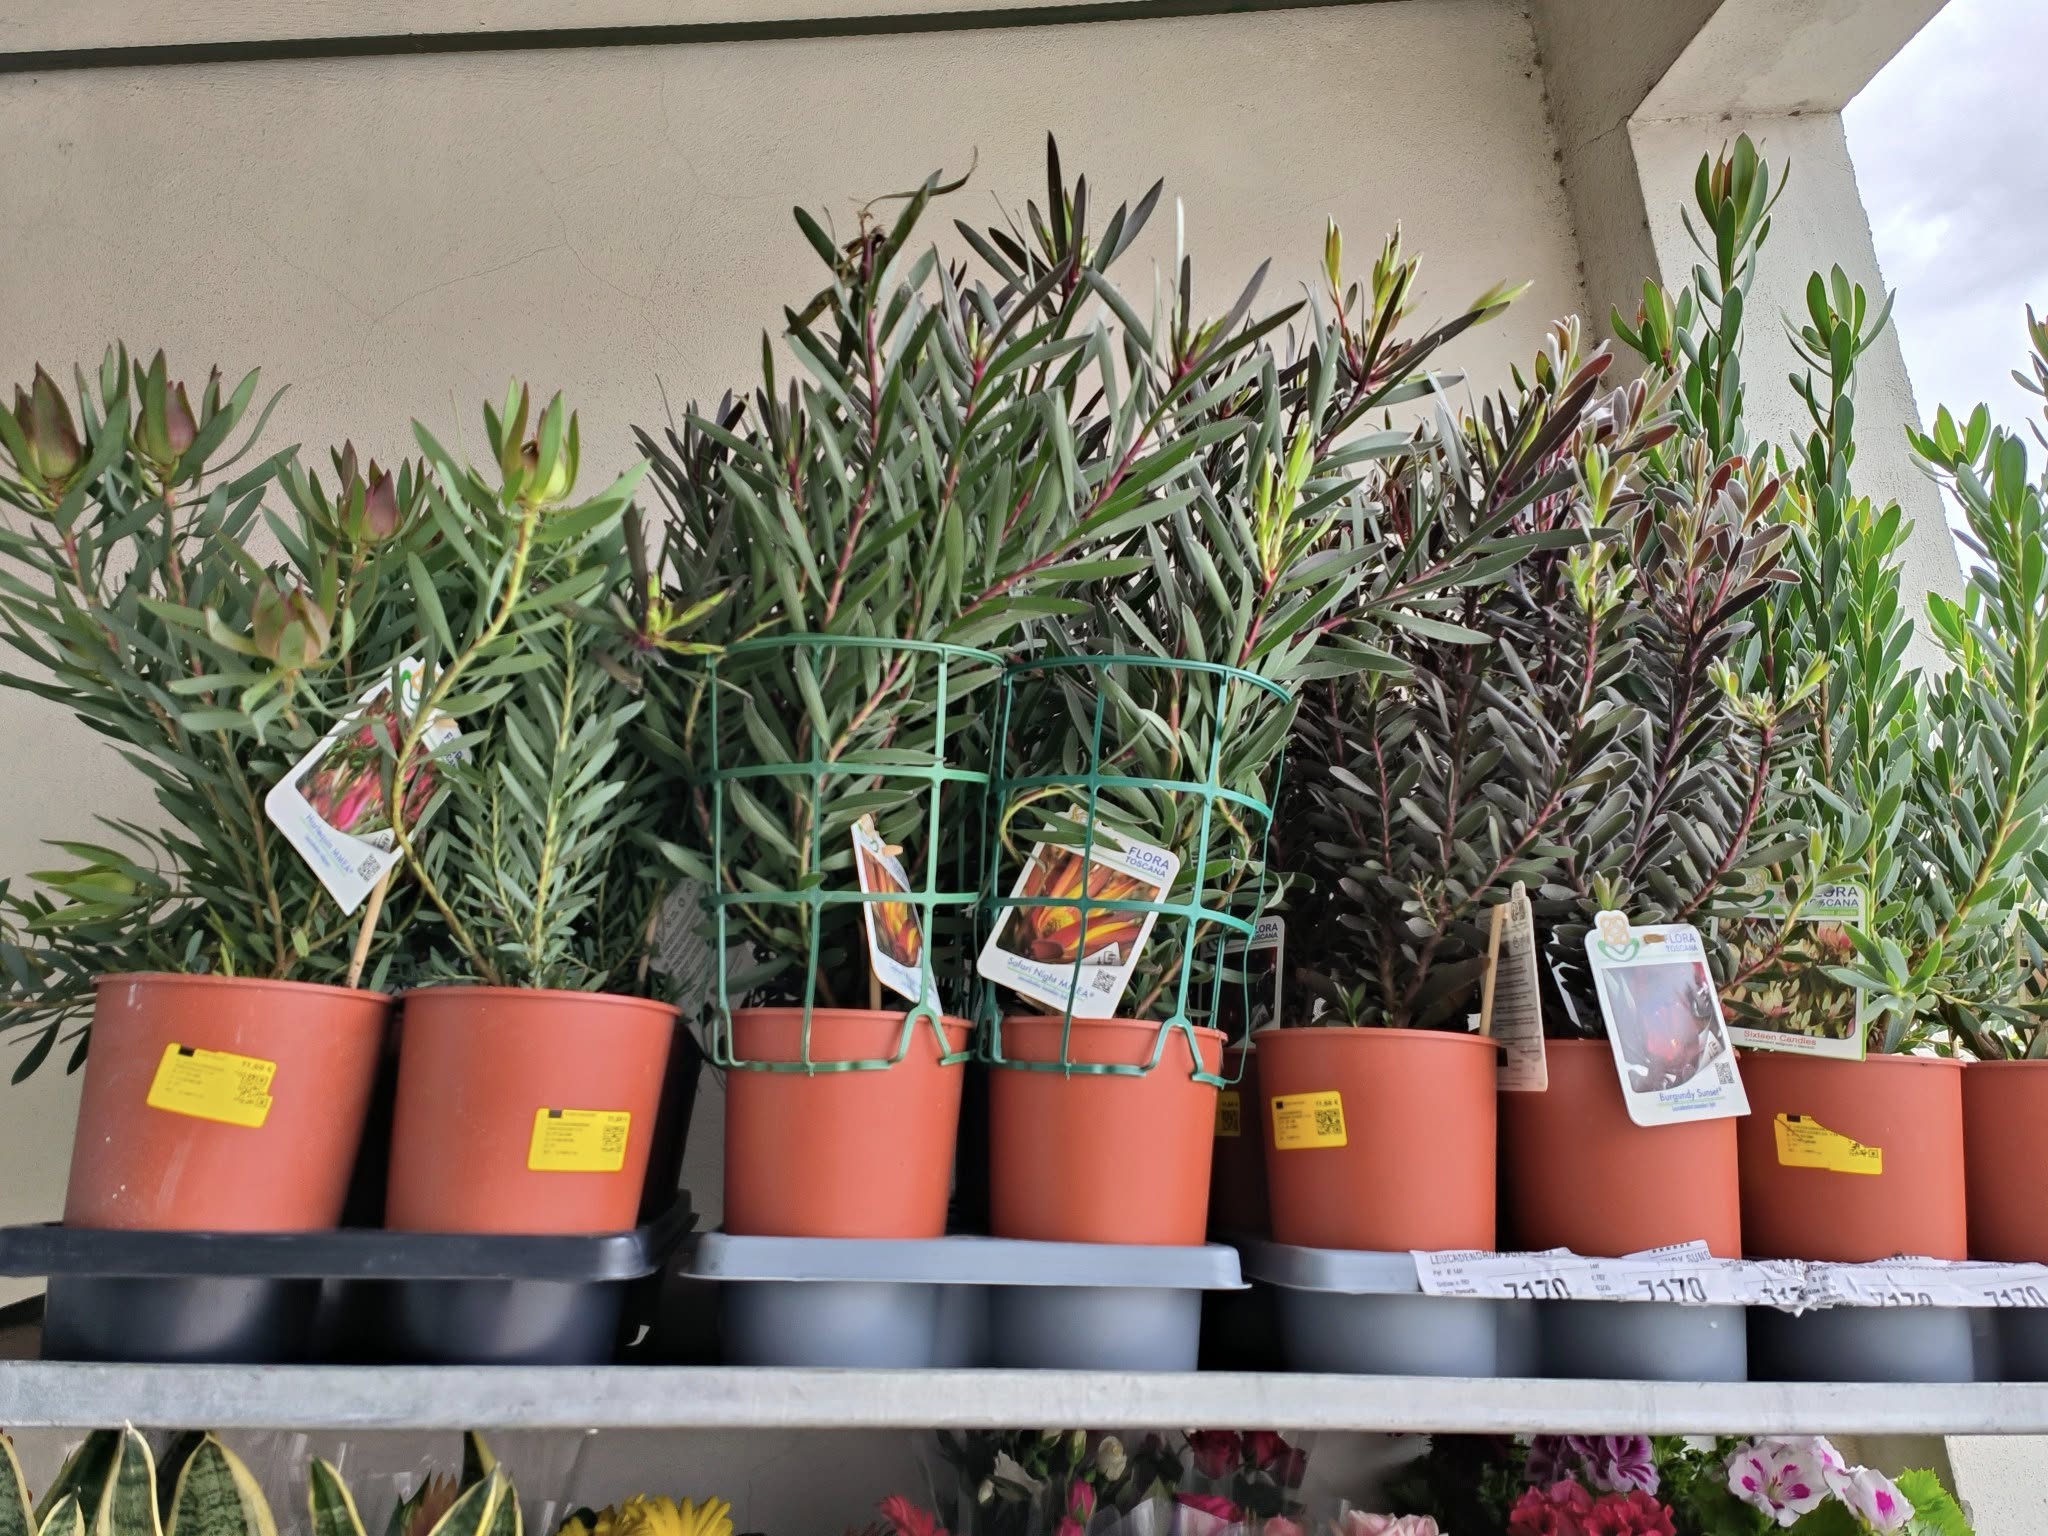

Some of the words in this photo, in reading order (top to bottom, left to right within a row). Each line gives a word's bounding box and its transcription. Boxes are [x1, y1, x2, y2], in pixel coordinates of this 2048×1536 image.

[1125, 855, 1166, 877] TOSCANA
[1128, 846, 1169, 870] FLORA
[1254, 922, 1278, 934] LORA
[1665, 943, 1698, 952] TOSCANA
[1007, 957, 1032, 973] Safari
[1033, 966, 1058, 984] Night
[1743, 1029, 1777, 1041] Sixteen
[1779, 1033, 1817, 1046] Candles
[1659, 1089, 1695, 1102] Burgundy
[1503, 1278, 1572, 1299] 7170
[1638, 1276, 1708, 1302] 7170
